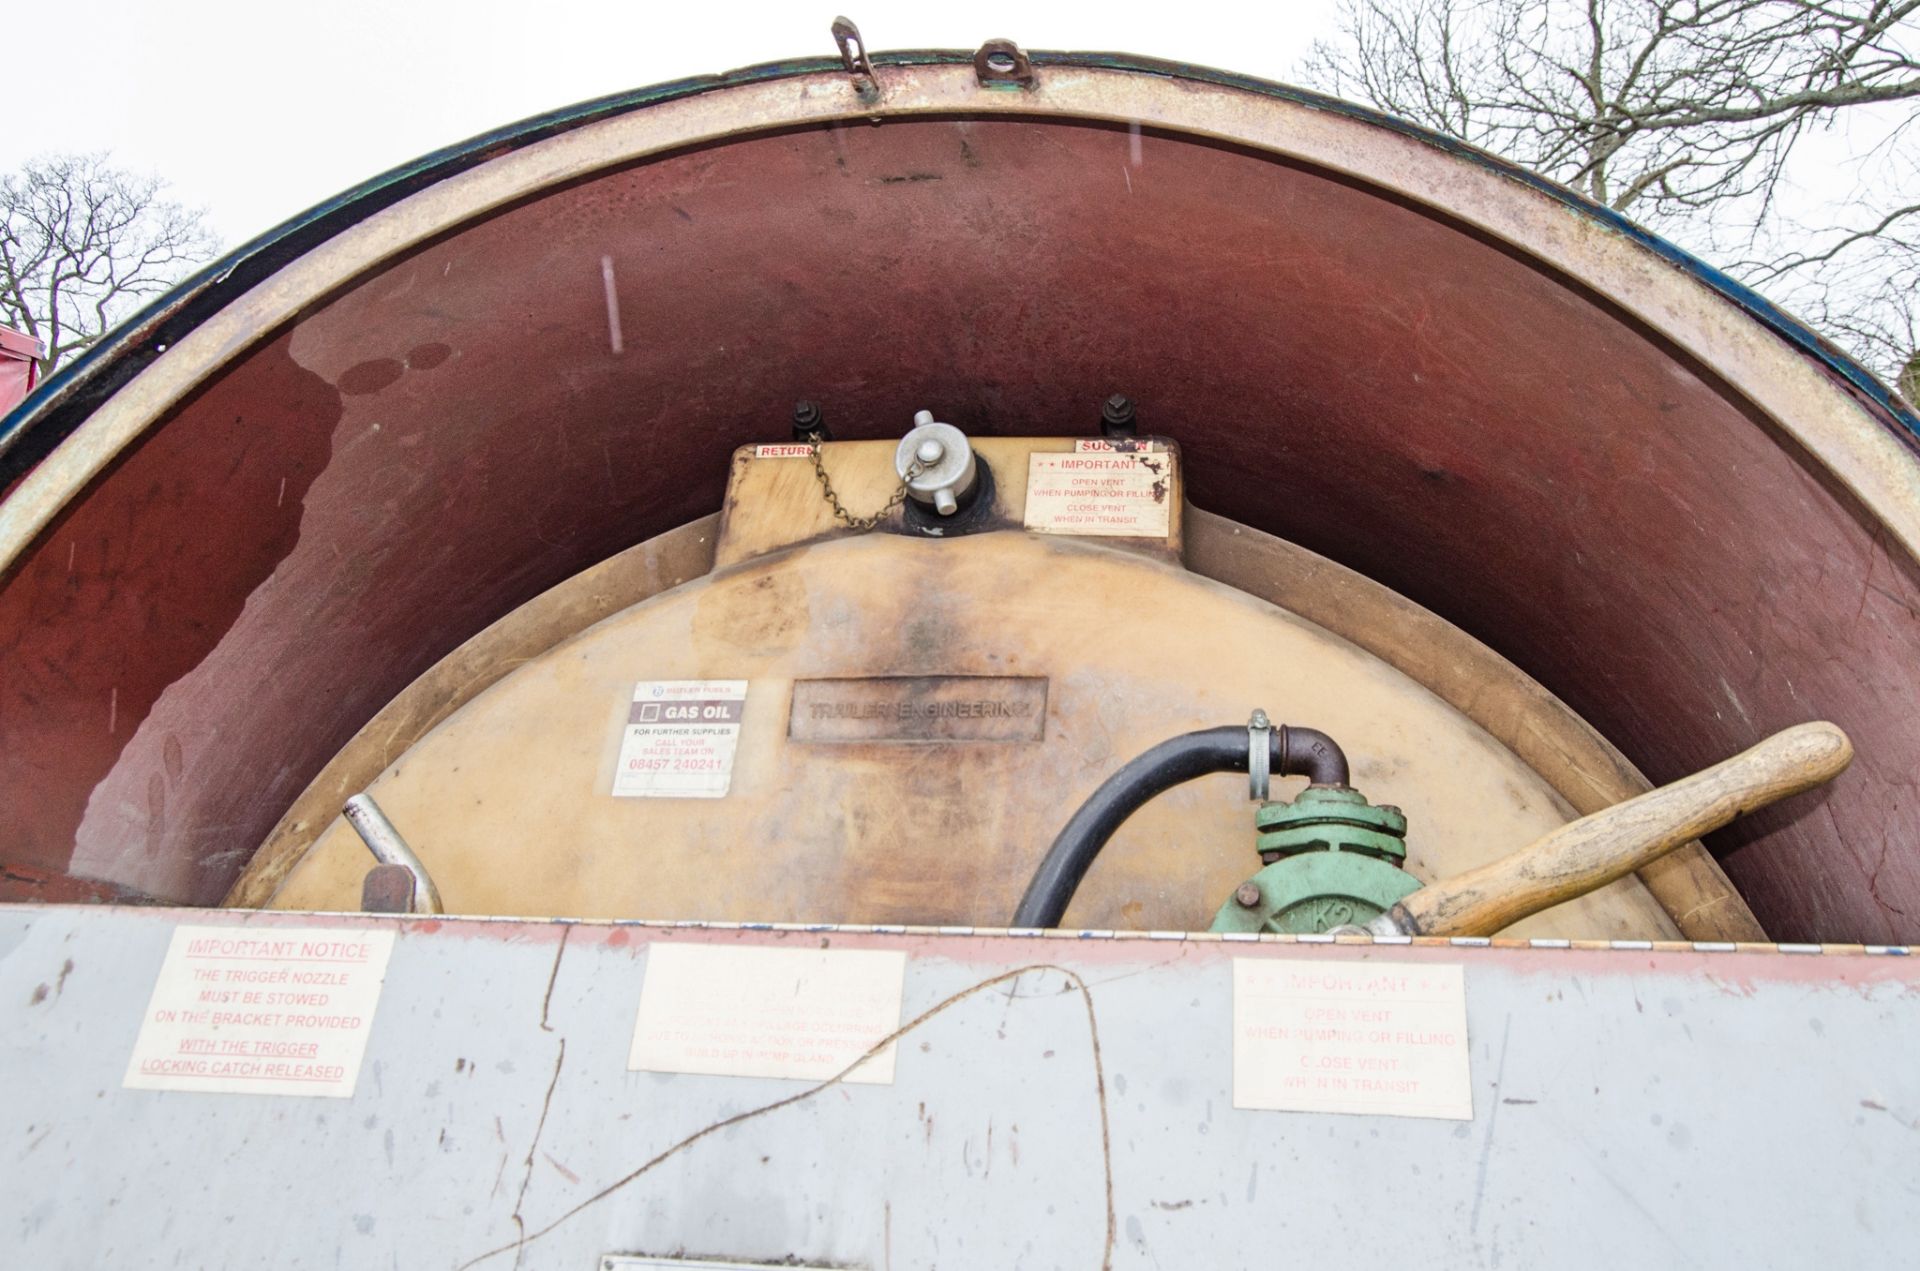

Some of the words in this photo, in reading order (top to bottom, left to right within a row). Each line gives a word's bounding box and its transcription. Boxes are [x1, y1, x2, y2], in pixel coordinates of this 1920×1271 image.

[1082, 440, 1147, 450] SUCN
[1061, 460, 1136, 469] IMPORTANT
[1072, 478, 1098, 486] OPEN
[1034, 489, 1061, 497] WHEN
[1064, 489, 1108, 498] PUMPING
[1109, 490, 1124, 498] OR
[1126, 490, 1162, 498] FILLIN
[1067, 503, 1100, 511] CLOSE
[1102, 504, 1126, 512] VENT
[1055, 515, 1083, 523] WHEN
[1098, 516, 1137, 524] TRANSIT
[665, 706, 699, 719] GAS
[703, 706, 731, 719] OIL
[809, 702, 889, 719] TRAILER
[899, 702, 1033, 718] ENGINEERING
[634, 728, 651, 736] FOR
[701, 747, 714, 755] ON
[629, 759, 670, 770] 08457
[673, 759, 722, 770] 240241
[188, 939, 297, 958] IMPORTANT
[300, 942, 370, 959] NOTICE
[194, 968, 220, 982] THE
[224, 970, 288, 984] TRIGGER
[292, 972, 349, 986] NOZZLE
[1285, 974, 1409, 992] MPORANT
[200, 990, 240, 1004] MUST
[242, 991, 262, 1005] BE
[266, 993, 329, 1007] STOWED
[155, 1010, 175, 1023] ON
[181, 1011, 207, 1024] THE
[212, 1012, 282, 1027] BRACKET
[285, 1014, 361, 1030] PROVIDED
[1304, 1007, 1347, 1021] OPEN
[1351, 1009, 1392, 1022] VENT
[1245, 1027, 1288, 1040] WHEN
[1296, 1028, 1363, 1043] PUMPING
[1368, 1031, 1391, 1043] OR
[1396, 1032, 1456, 1046] FILLING
[180, 1038, 217, 1053] WITH
[221, 1040, 249, 1055] THE
[254, 1041, 319, 1056] TRIGGER
[818, 1038, 885, 1050] PRESSUR
[141, 1059, 207, 1075] LOCKING
[211, 1061, 260, 1076] CATCH
[265, 1063, 345, 1079] RELEASED
[1357, 1058, 1400, 1071] VENT
[1284, 1076, 1328, 1089] WHN
[1331, 1078, 1348, 1090] IN
[1354, 1079, 1420, 1093] TRANSIT
